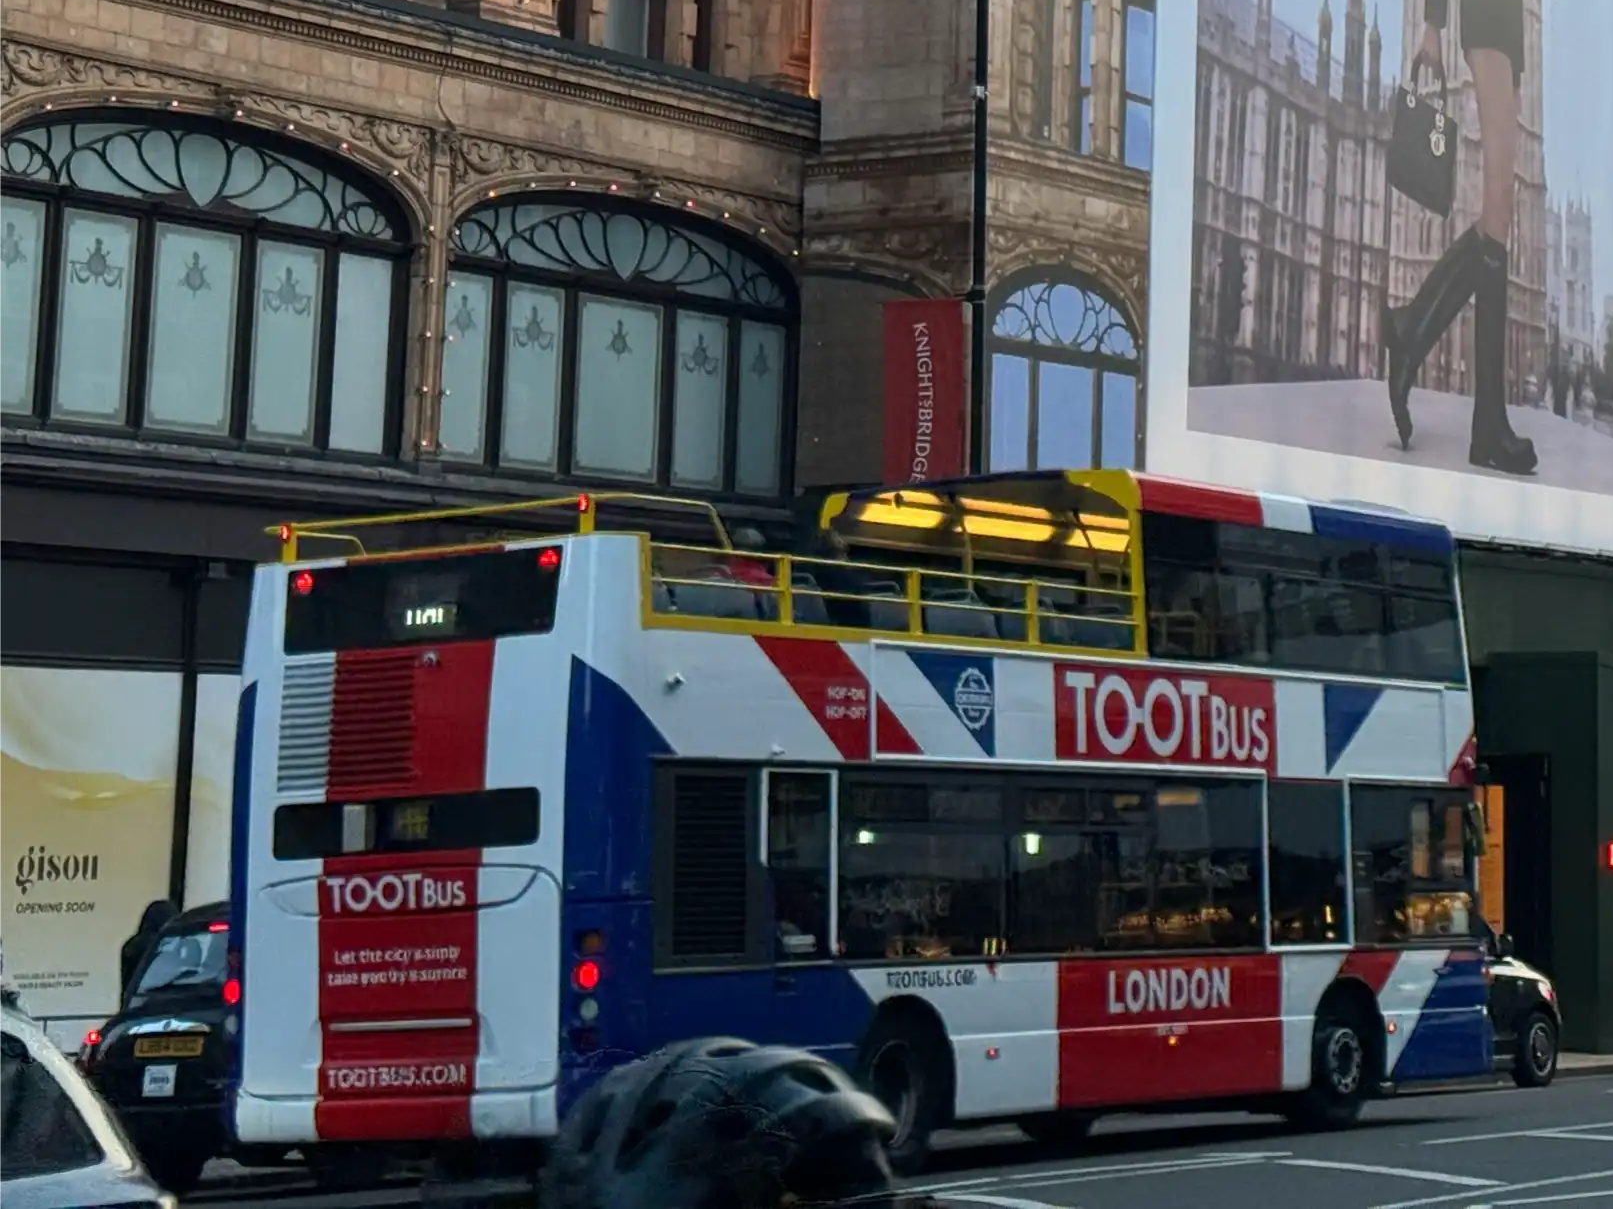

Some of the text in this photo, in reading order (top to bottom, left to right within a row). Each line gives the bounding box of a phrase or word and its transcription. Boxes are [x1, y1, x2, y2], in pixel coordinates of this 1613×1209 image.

[15, 845, 99, 896] gisou
[15, 901, 96, 915] OPENING SOON
[334, 949, 357, 965] Let
[1108, 966, 1231, 1014] LONDON
